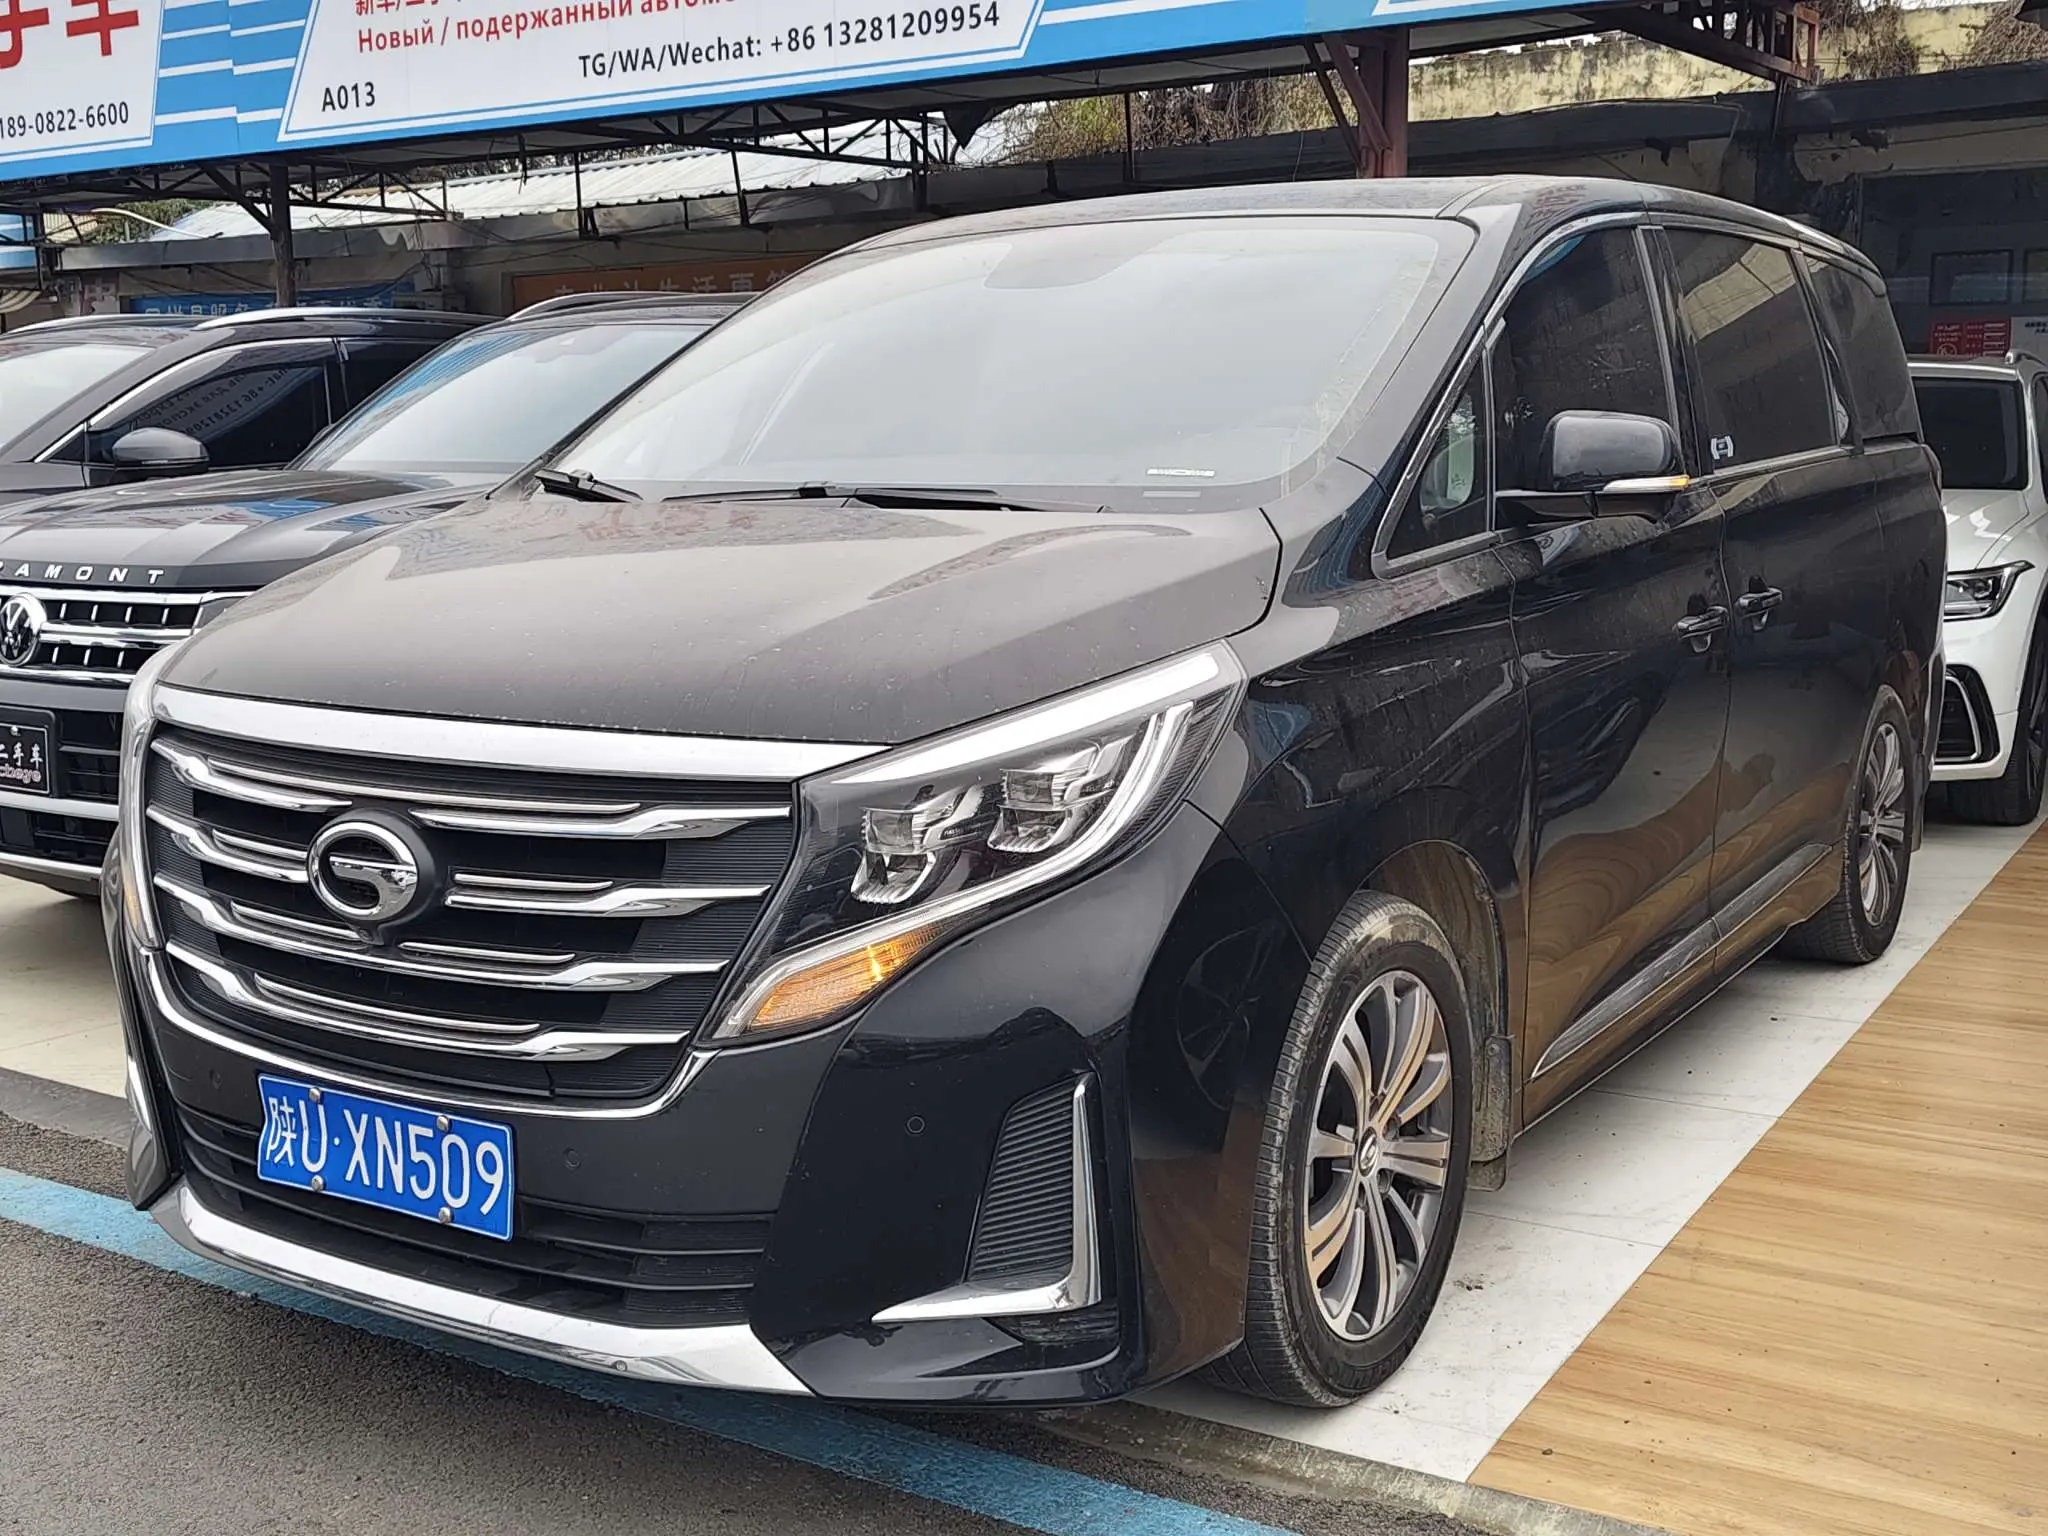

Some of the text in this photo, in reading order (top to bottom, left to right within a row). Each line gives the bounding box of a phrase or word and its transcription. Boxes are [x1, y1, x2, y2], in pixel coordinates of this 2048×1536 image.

[358, 19, 434, 53] Новый
[457, 0, 633, 42] подержанный
[578, 1, 1000, 78] TG/WA/Wechat: +86 13281209954
[322, 81, 376, 112] A013
[0, 561, 164, 585] AMONT
[266, 1096, 504, 1216] 陕U·XN509
